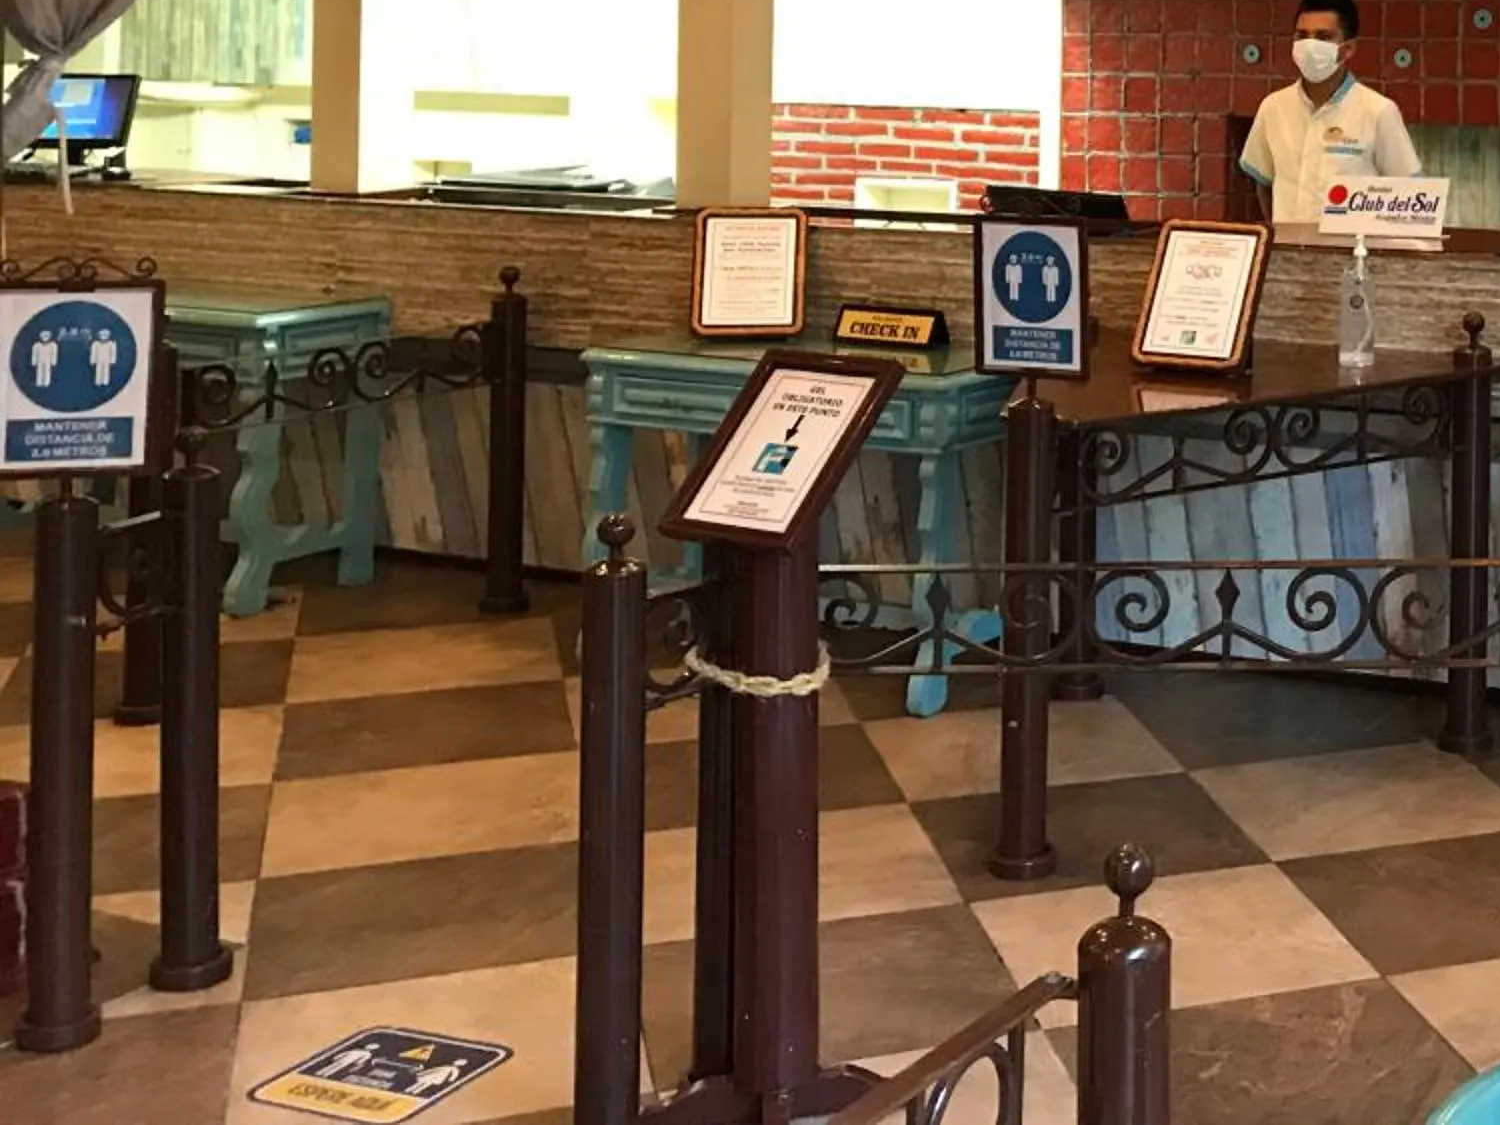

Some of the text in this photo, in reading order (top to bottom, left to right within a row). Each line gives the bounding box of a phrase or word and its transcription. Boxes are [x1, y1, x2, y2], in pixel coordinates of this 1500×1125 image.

[1349, 191, 1440, 214] Club del Sol
[849, 321, 921, 340] CHECK IN
[781, 393, 843, 407] OBLIGATORIO
[772, 402, 786, 411] EN
[808, 406, 841, 417] PUNTO
[34, 420, 106, 432] MANTENER
[24, 432, 115, 446] DISTANCIA DE
[52, 445, 107, 458] METROS
[287, 1081, 352, 1104] ESPERE
